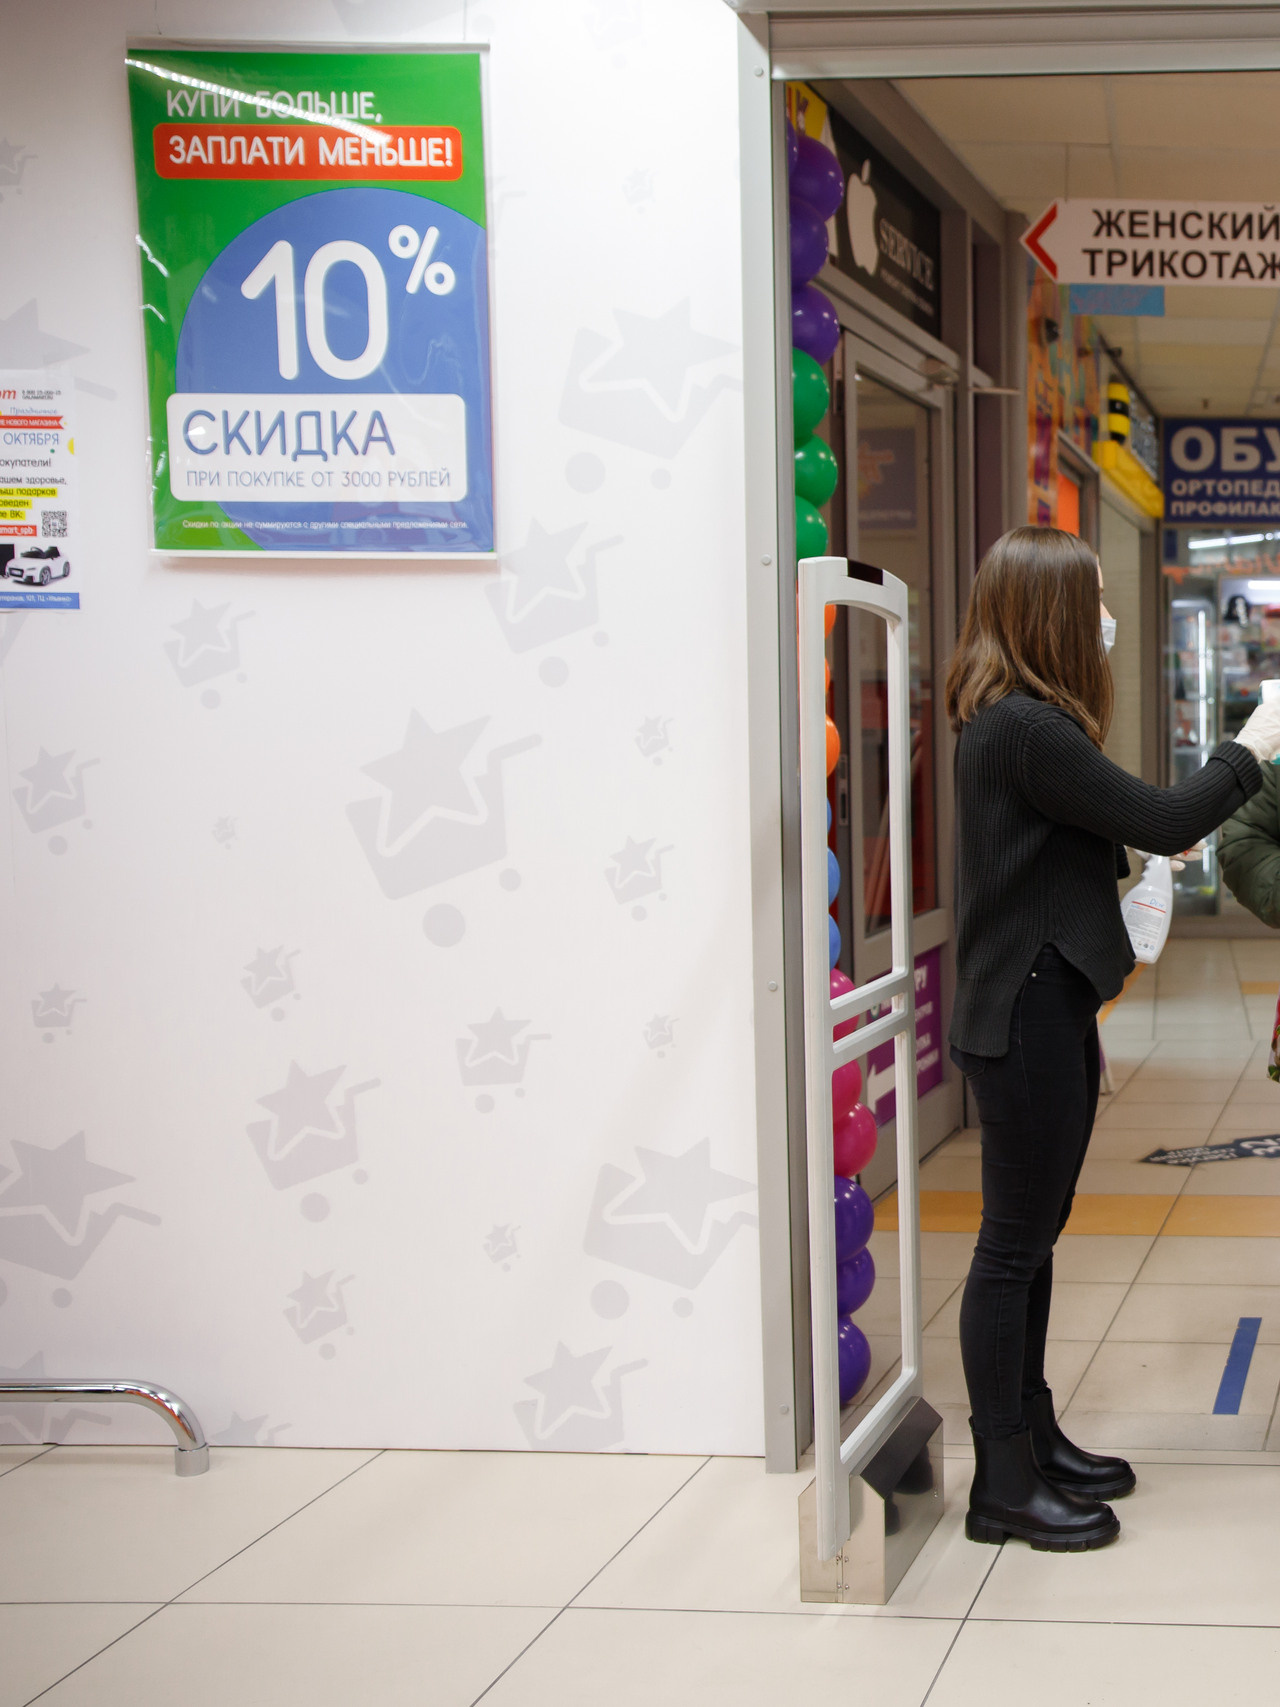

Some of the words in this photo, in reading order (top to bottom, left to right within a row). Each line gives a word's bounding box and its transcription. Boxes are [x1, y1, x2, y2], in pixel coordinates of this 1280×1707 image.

[166, 89, 240, 119] КУПИ
[256, 91, 382, 123] БОЛЬШЕ,
[169, 135, 305, 166] ЗАПЛАТИ
[319, 136, 453, 167] МЕНЬШЕ!
[1092, 204, 1280, 241] ЖЕНСКИЙ
[241, 224, 456, 380] 10%
[3, 432, 59, 446] ОКТЯБРЯ
[182, 409, 396, 462] СКИДКА
[186, 470, 220, 488] ПРИ
[227, 470, 305, 488] ПОКУПКЕ
[311, 470, 334, 488] ОТ
[341, 469, 382, 488] 3000
[388, 467, 451, 488] РУБЛЕЙ
